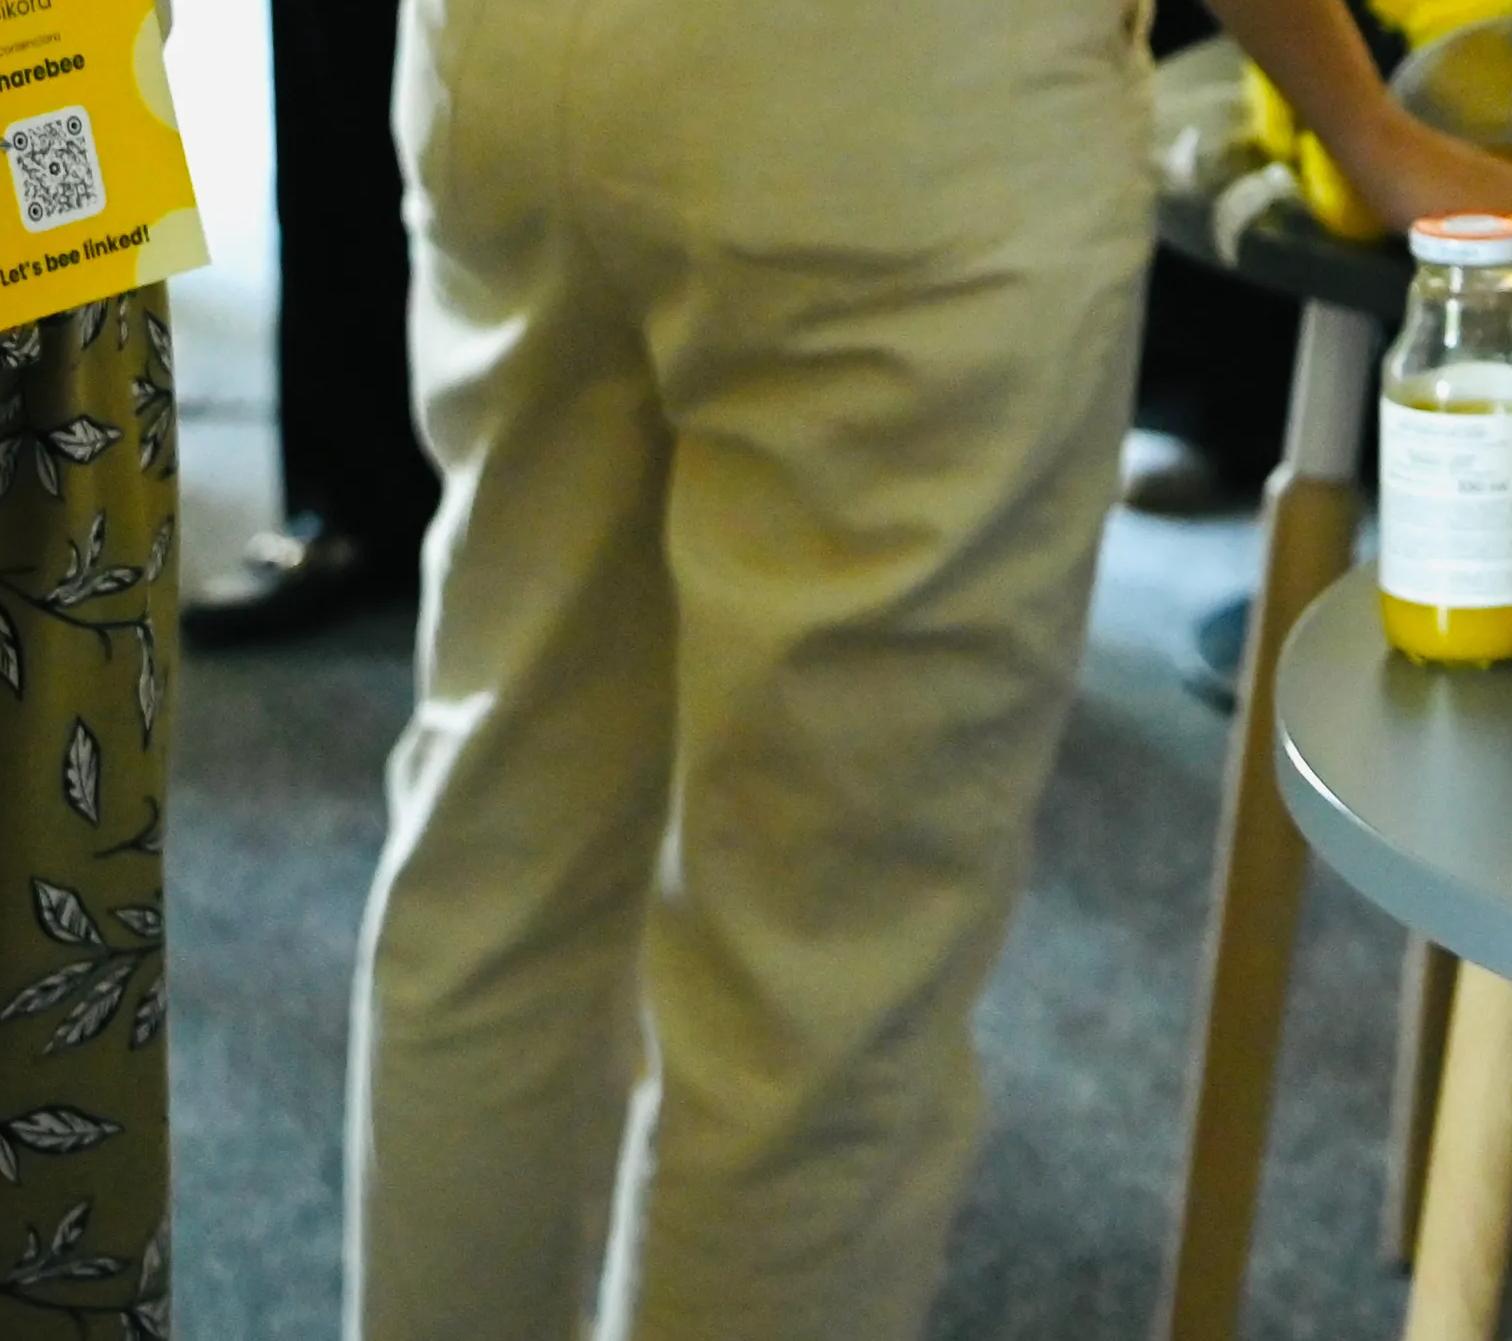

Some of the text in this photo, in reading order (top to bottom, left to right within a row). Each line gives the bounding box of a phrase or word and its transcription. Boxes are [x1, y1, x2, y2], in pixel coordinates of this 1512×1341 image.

[0, 224, 150, 286] Let's bee linked!
